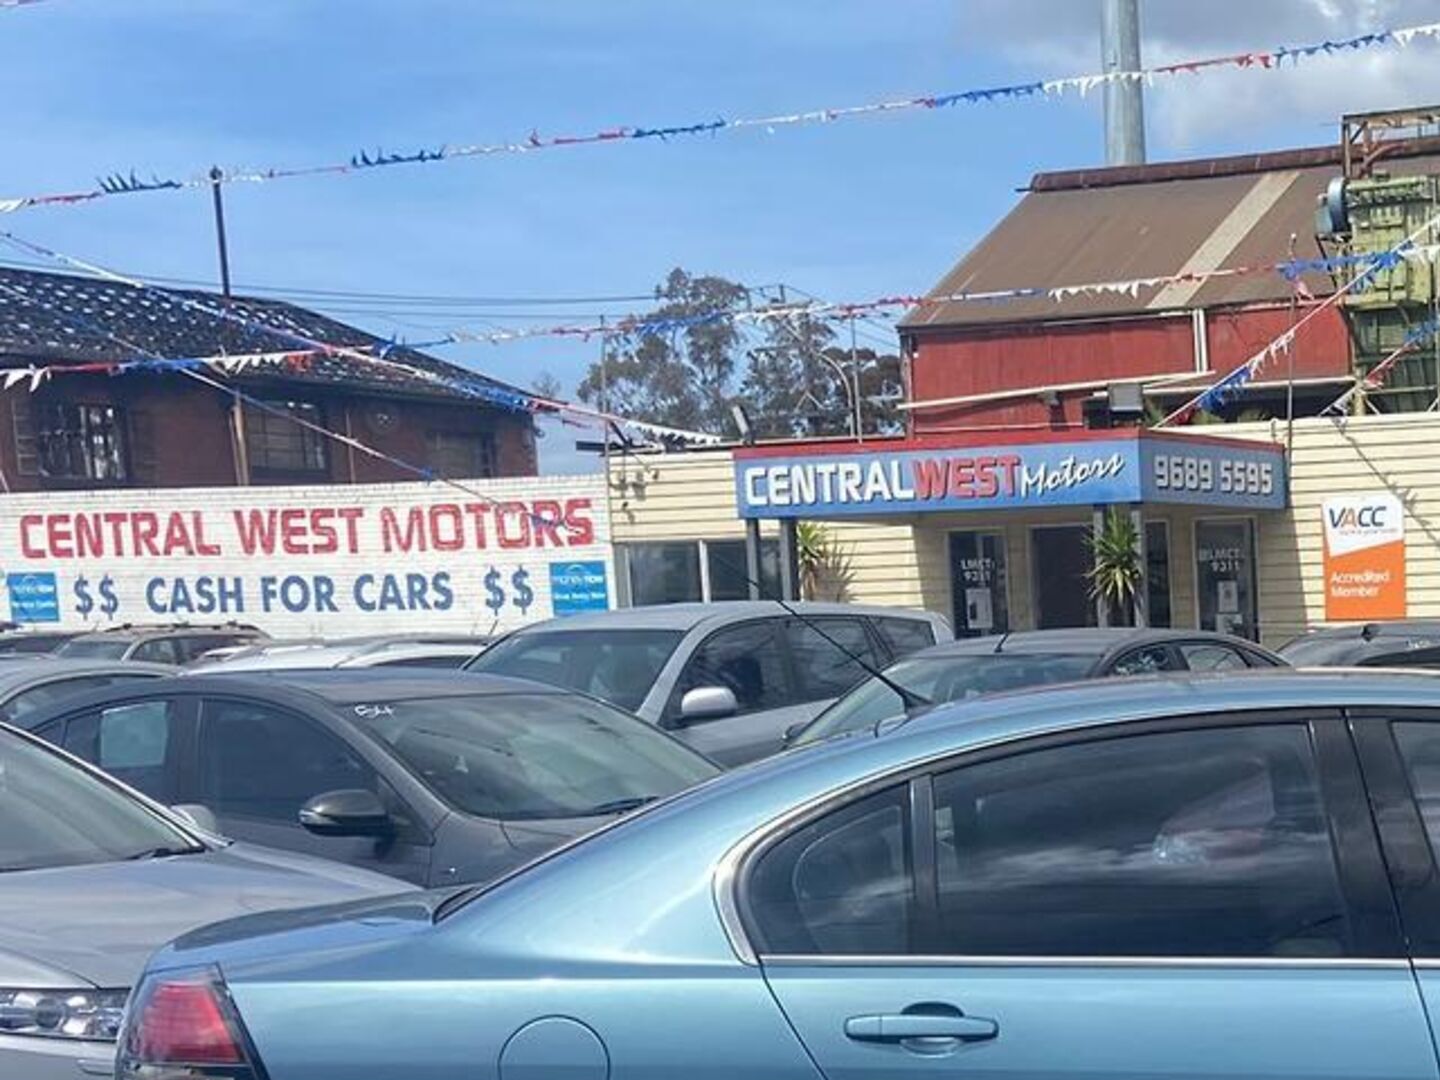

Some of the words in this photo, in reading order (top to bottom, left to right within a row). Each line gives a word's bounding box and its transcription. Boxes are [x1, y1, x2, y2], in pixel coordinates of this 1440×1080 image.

[1020, 452, 1125, 497] Motors
[1154, 455, 1213, 491] 9689
[1219, 460, 1274, 495] 5595
[19, 510, 222, 559] CENTRAL
[233, 508, 364, 555] WEST
[380, 498, 594, 552] MOTORS
[1328, 505, 1388, 529] VACC
[1330, 568, 1390, 583] Accredited
[1330, 585, 1380, 598] Member
[145, 576, 244, 614] CASH
[260, 574, 340, 613] FOR
[353, 571, 454, 612] CARS
